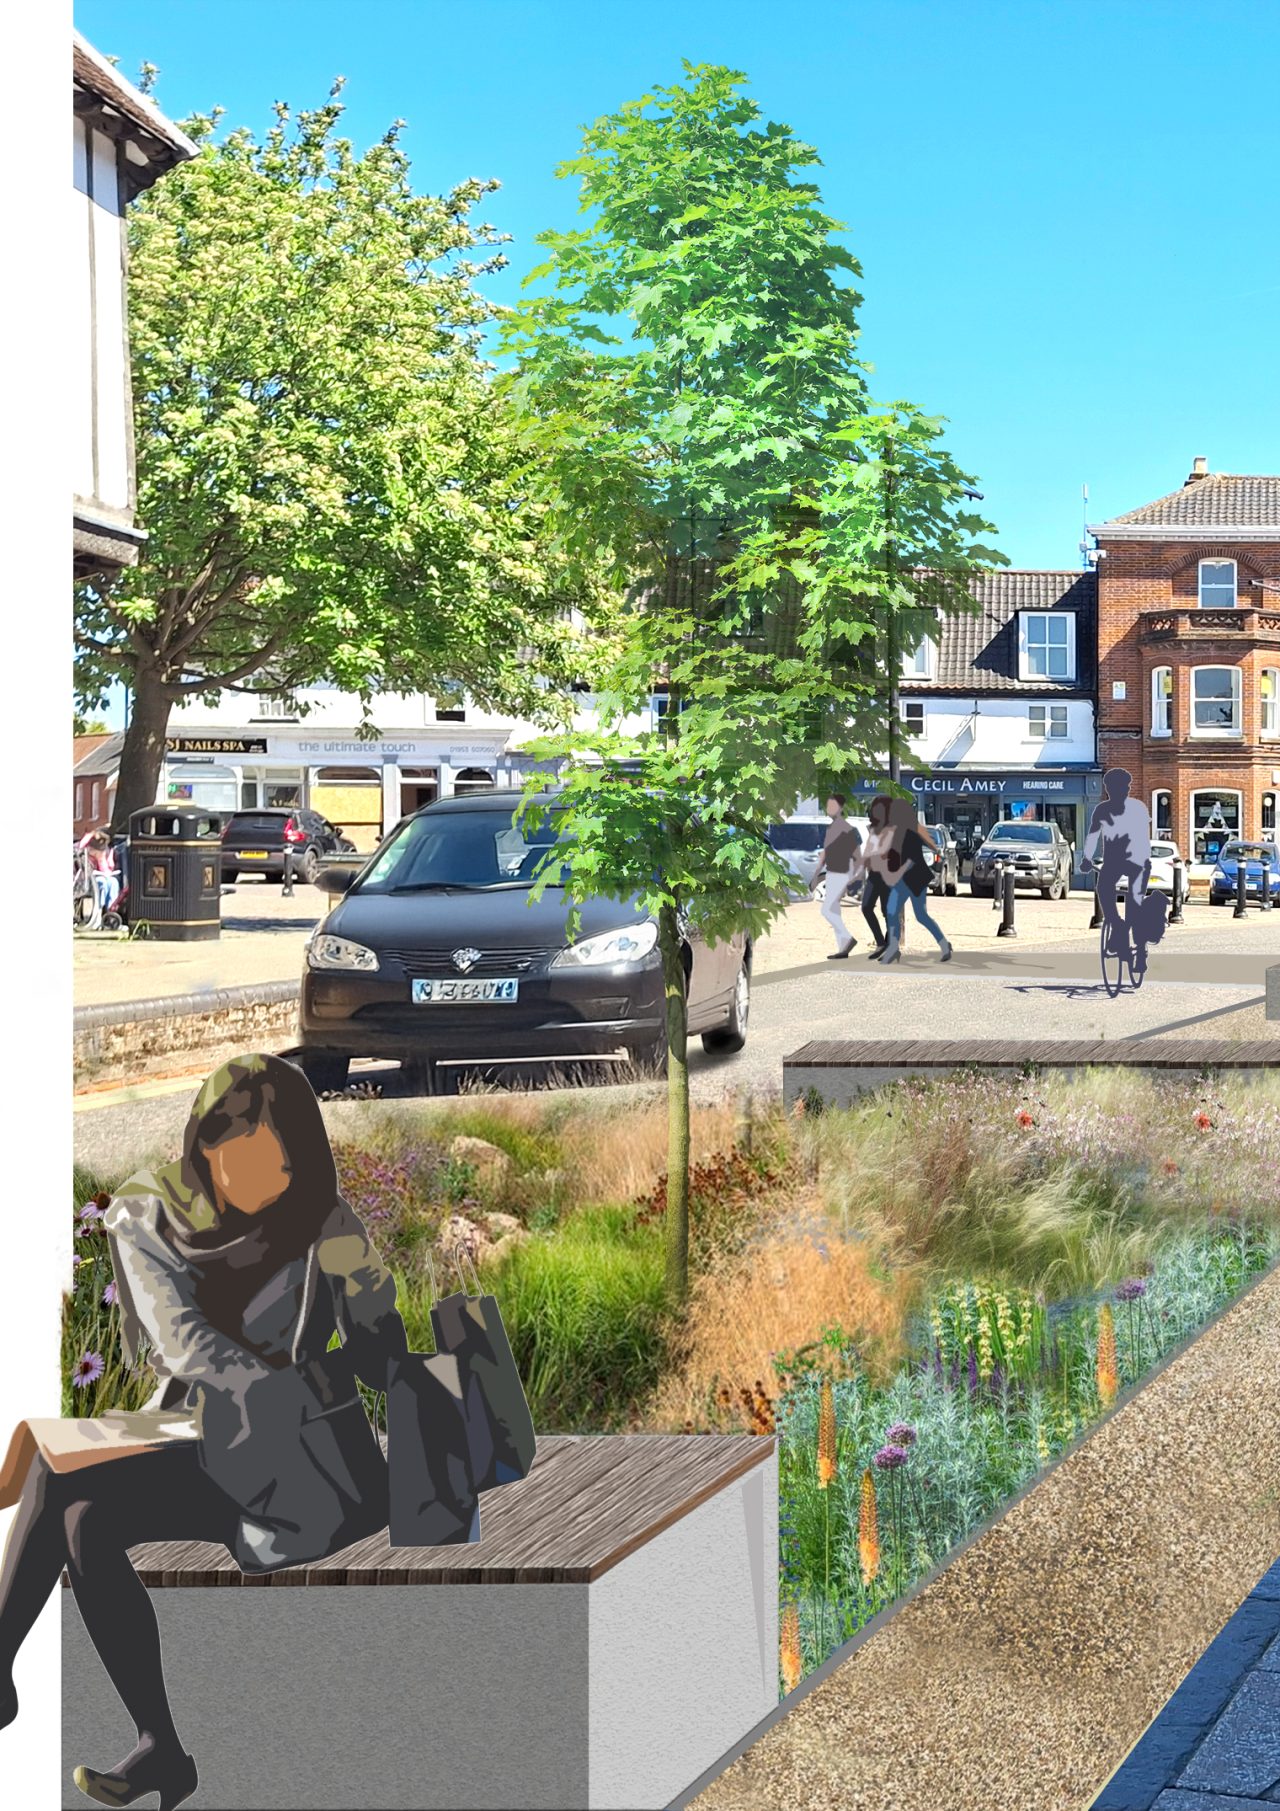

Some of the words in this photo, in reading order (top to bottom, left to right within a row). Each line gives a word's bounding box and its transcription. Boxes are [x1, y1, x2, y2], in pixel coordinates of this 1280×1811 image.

[184, 740, 221, 752] NAILS
[222, 740, 246, 752] SPA
[298, 740, 319, 753] the
[324, 740, 377, 753] ultimate
[381, 741, 416, 753] touch
[911, 777, 955, 792] CECIL
[960, 777, 1007, 792] AMEY
[1023, 780, 1048, 790] HEARING
[1048, 780, 1064, 790] CARE
